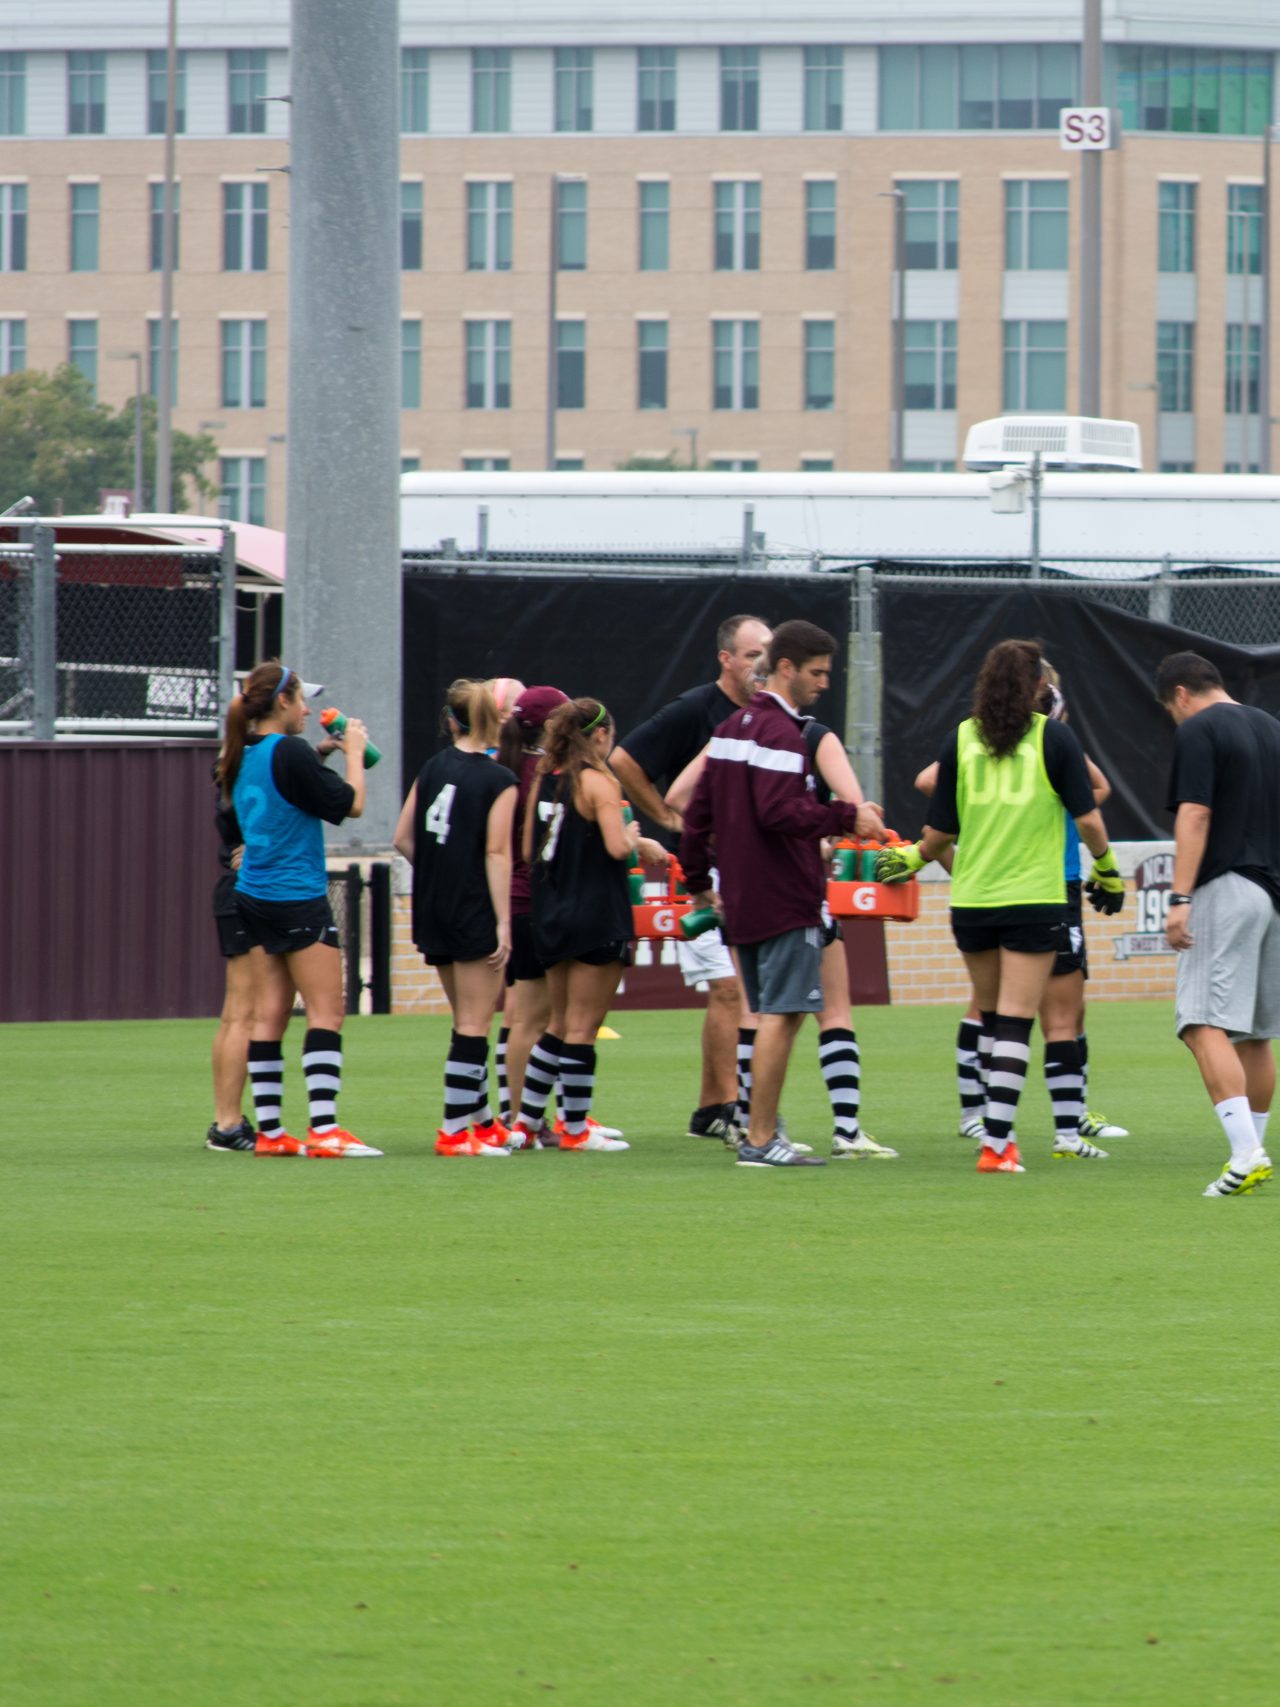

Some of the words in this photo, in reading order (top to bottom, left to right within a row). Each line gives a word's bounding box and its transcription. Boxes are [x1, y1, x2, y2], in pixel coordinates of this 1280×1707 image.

[1065, 114, 1105, 143] S3
[242, 784, 270, 848] 2
[425, 783, 457, 845] 4
[853, 887, 877, 911] G
[652, 909, 675, 932] G
